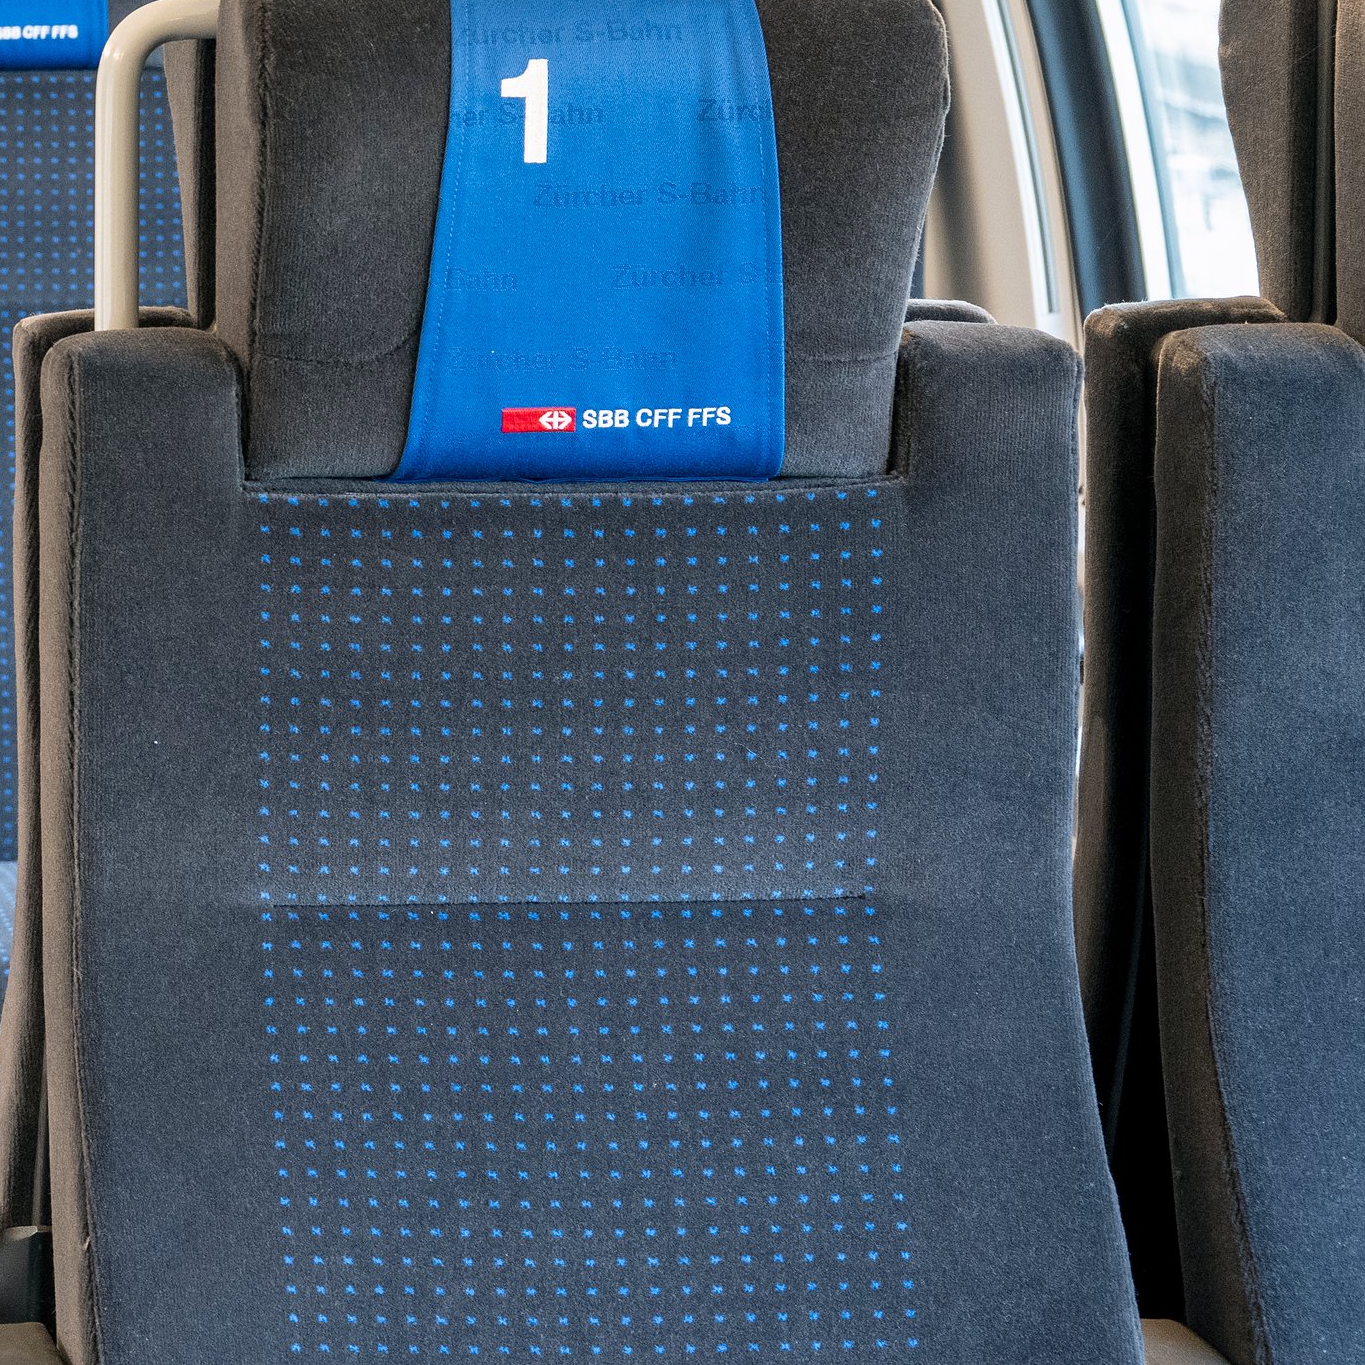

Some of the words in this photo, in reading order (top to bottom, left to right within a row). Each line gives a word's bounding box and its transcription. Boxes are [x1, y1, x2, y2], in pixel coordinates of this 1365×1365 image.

[501, 58, 548, 164] 1
[583, 409, 629, 429] SBB
[636, 408, 682, 428] CFF
[688, 406, 731, 427] FFS
